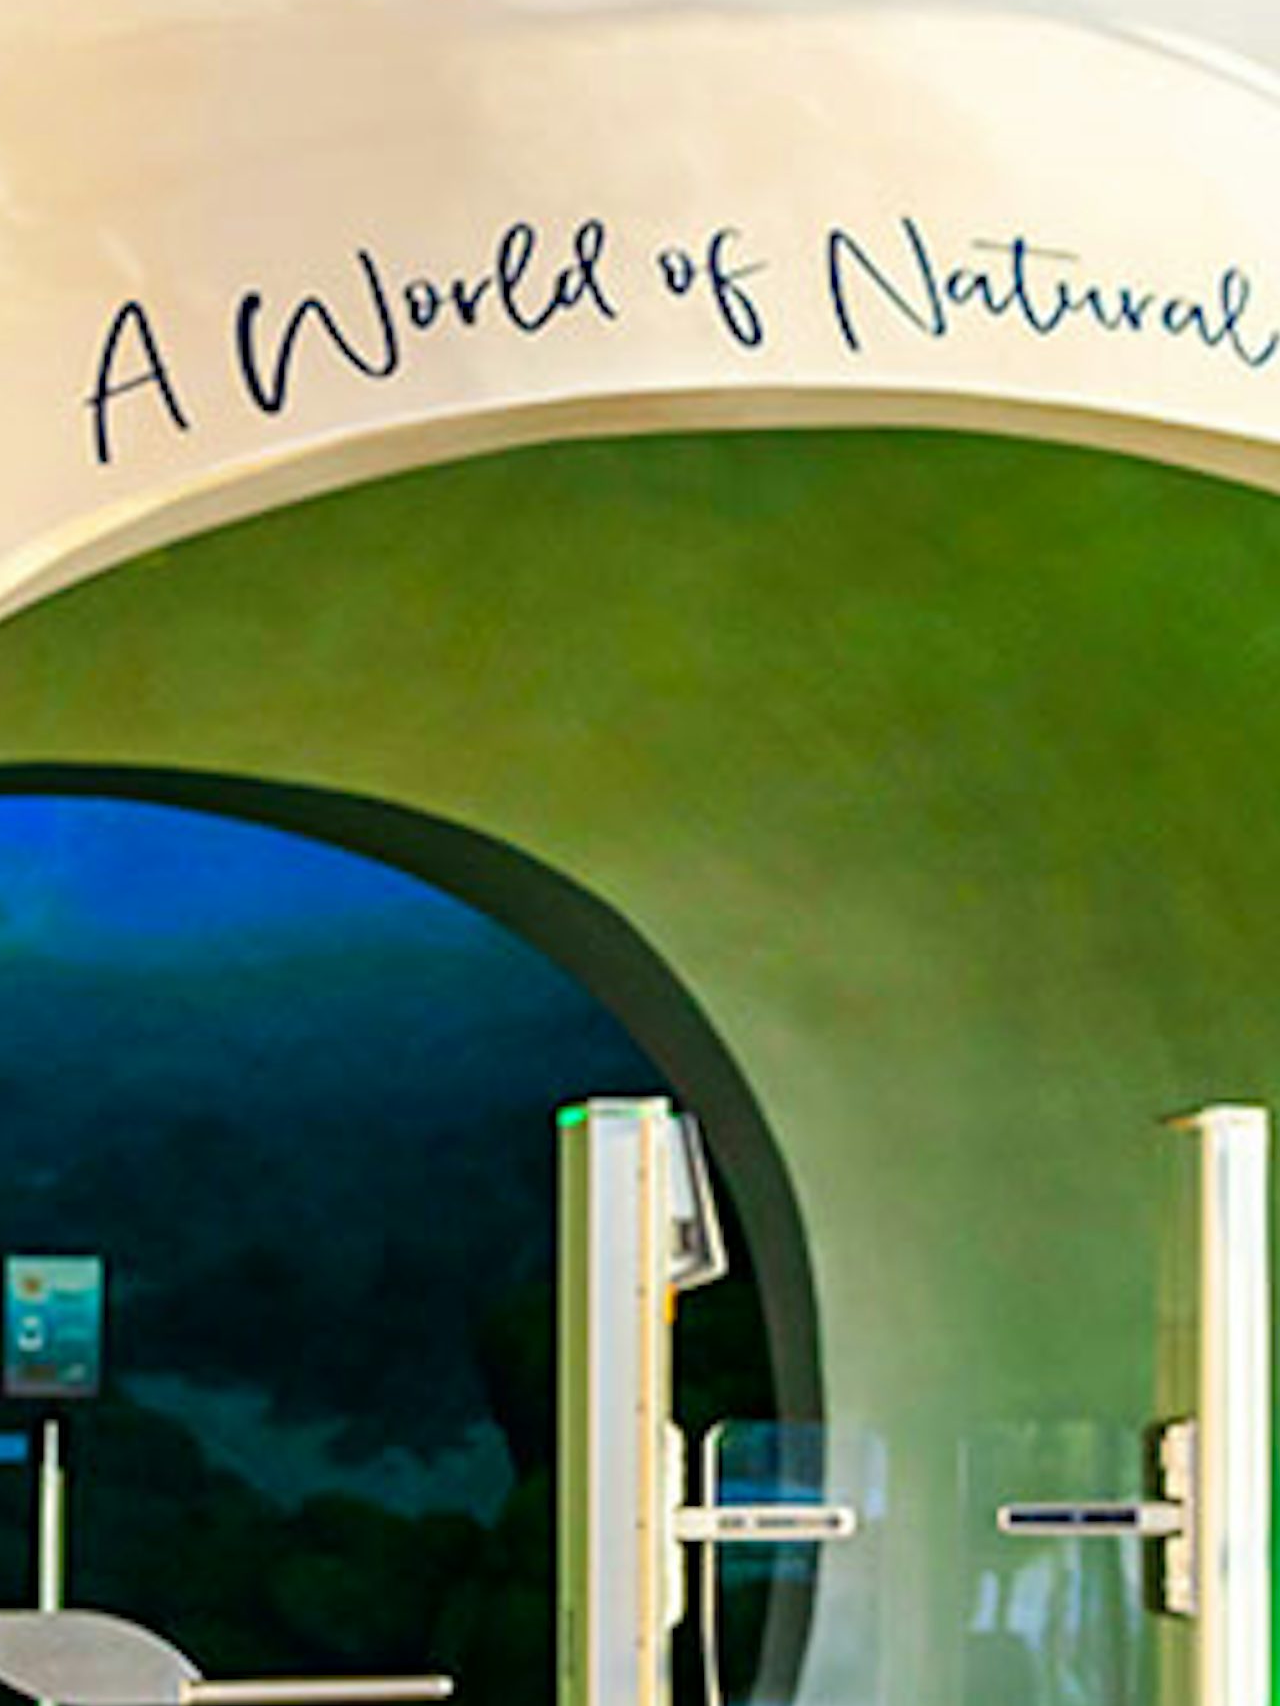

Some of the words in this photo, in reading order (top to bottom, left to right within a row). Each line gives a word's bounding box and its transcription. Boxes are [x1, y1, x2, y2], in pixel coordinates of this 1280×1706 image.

[85, 301, 190, 464] A
[236, 218, 617, 415] World
[657, 228, 769, 349] of
[826, 216, 1280, 369] Natural
